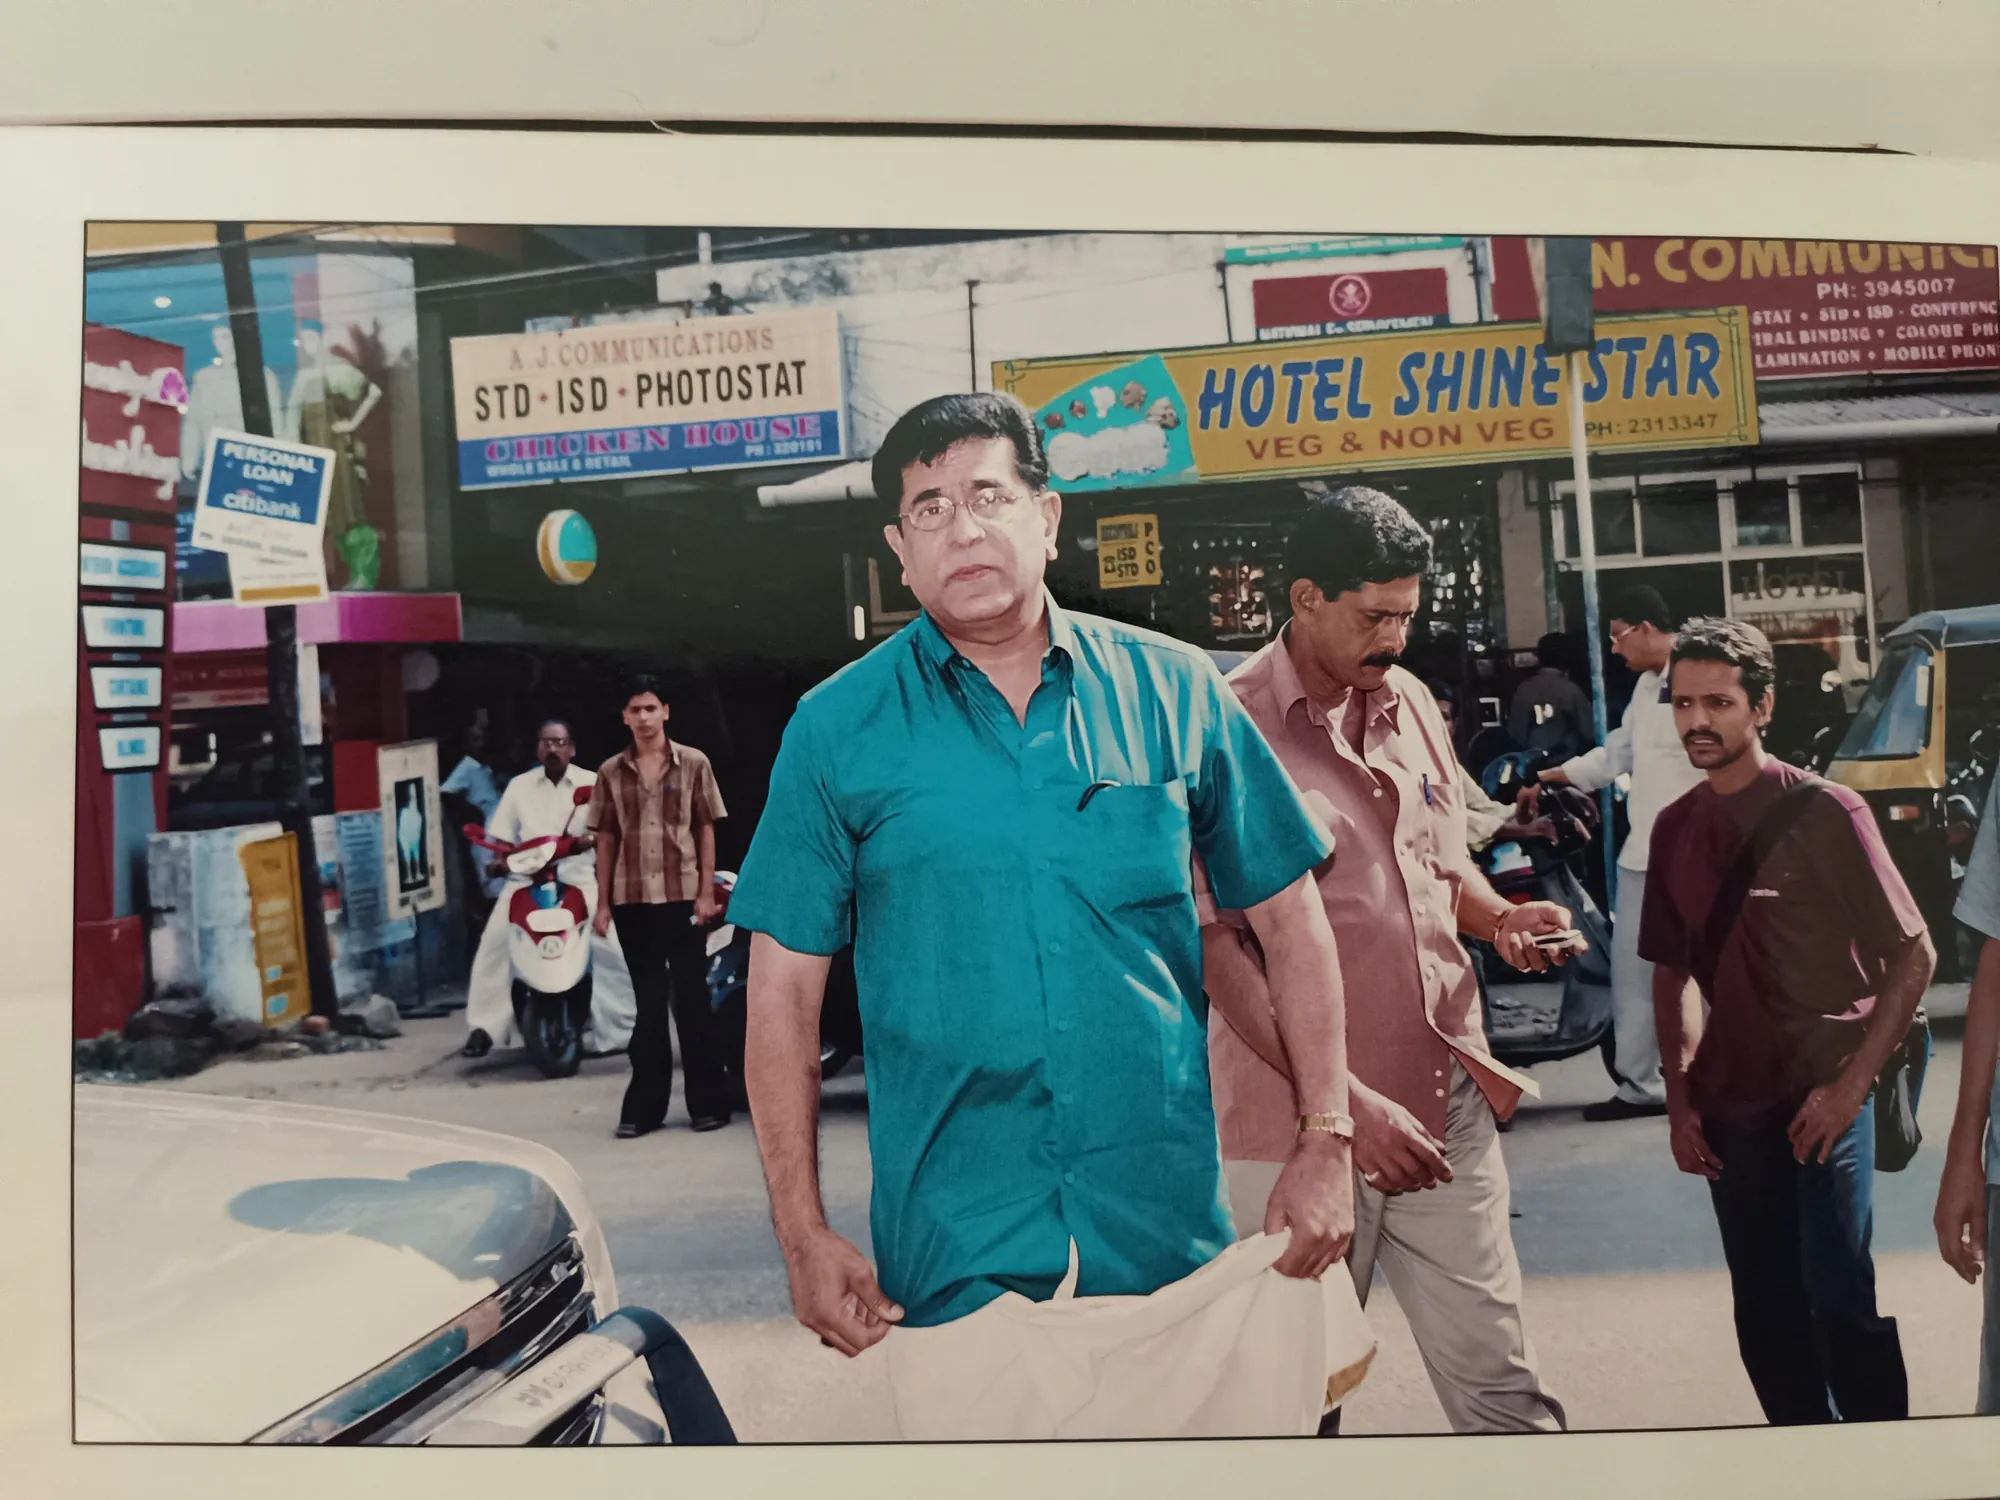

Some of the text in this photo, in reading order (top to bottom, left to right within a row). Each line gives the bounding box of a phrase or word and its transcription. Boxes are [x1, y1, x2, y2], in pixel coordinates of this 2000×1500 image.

[1816, 278, 1956, 300] PH: 3945007
[1819, 306, 1850, 322] STD
[1866, 304, 1894, 319] ISD
[1799, 326, 1871, 344] BINDING
[1895, 323, 1964, 340] COLOUR
[1754, 349, 1861, 368] LAMINATION
[1883, 345, 1946, 362] MOBILE
[475, 360, 806, 421] STD ISD PHOTOSTAT
[1198, 332, 1721, 431] HOTEL SHINE STAR
[1627, 413, 1718, 434] 2313347
[485, 414, 822, 463] CHICKEN HOUSE
[1245, 417, 1555, 460] VEG & NON VEG
[223, 440, 318, 475] PERSONAL
[241, 463, 295, 487] LOAN
[1116, 546, 1137, 561] ISD
[1741, 569, 1853, 601] HOTEL
